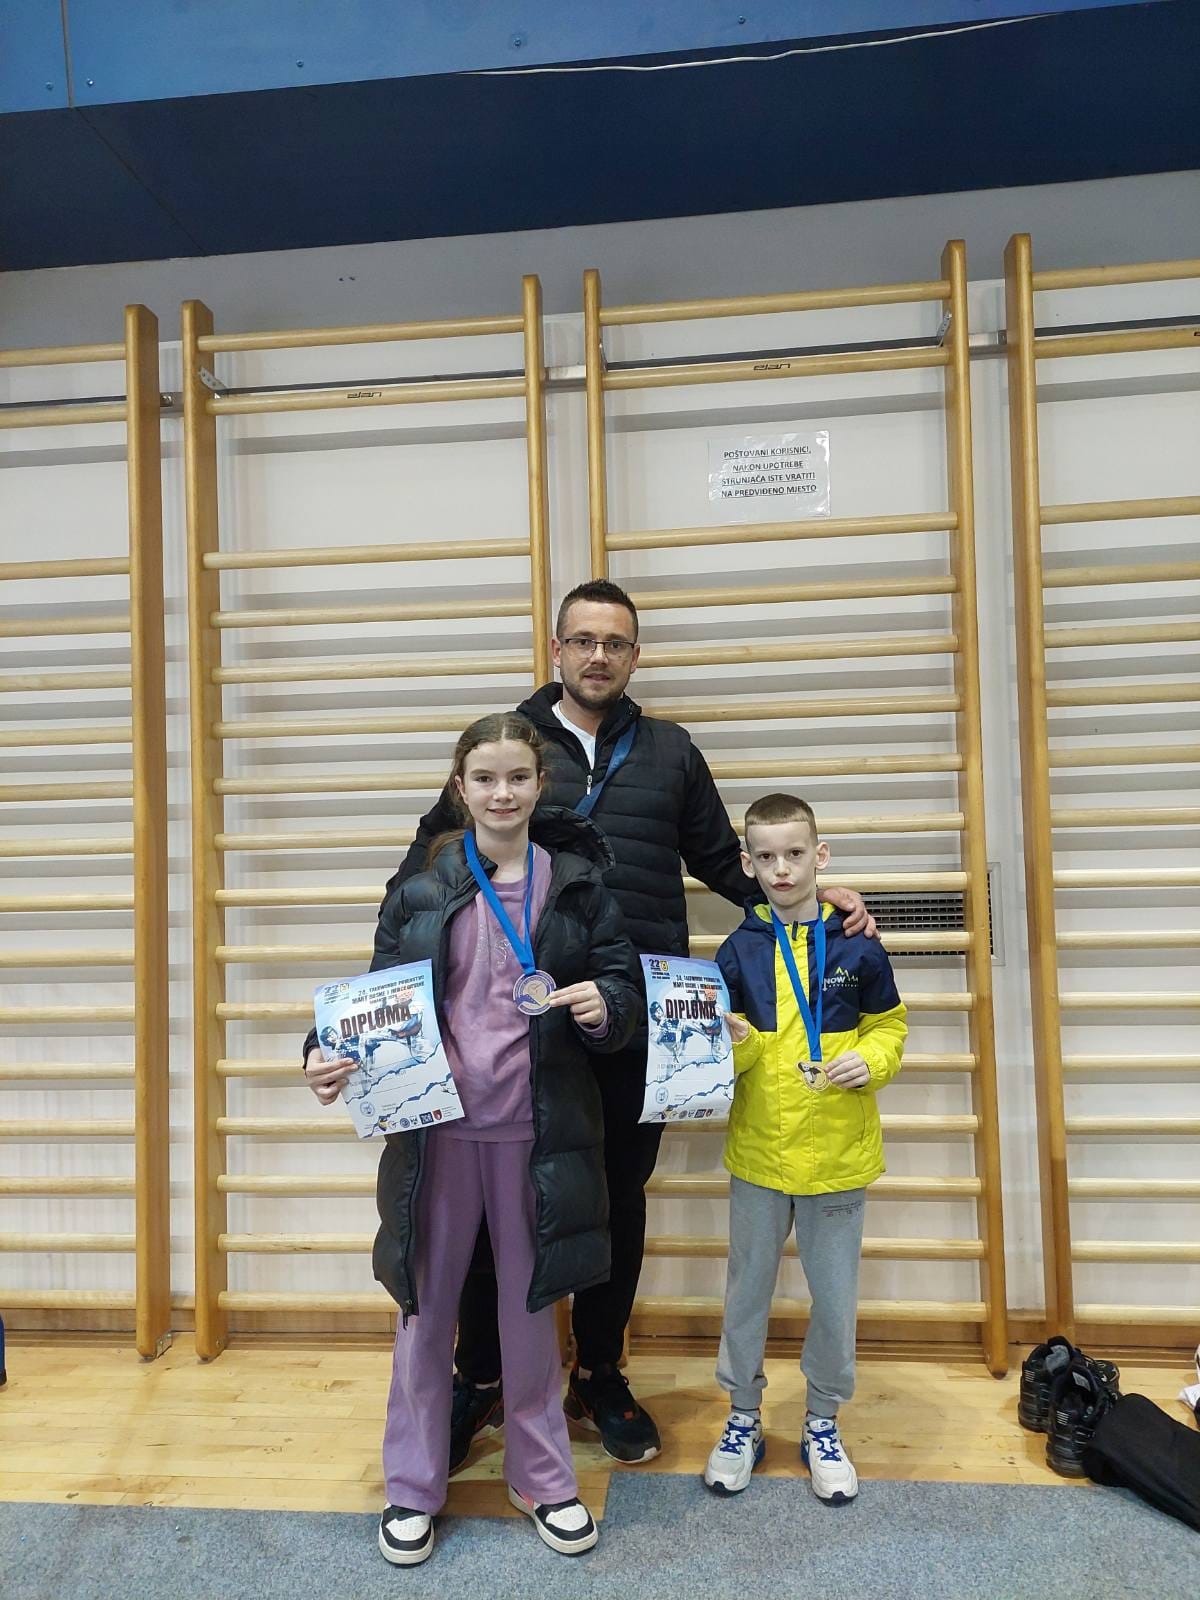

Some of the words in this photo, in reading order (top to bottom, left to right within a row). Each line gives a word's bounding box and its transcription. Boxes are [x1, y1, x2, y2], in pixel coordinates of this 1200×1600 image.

[723, 449, 769, 460] POŠTOVANI
[770, 445, 812, 456] KORISNICI,
[732, 463, 761, 473] NAKON
[763, 460, 804, 471] UPOTREBE
[721, 475, 766, 486] STRUNJAČA
[768, 474, 783, 482] ISTE
[785, 471, 816, 481] VRATITI
[721, 489, 733, 498] NA
[786, 484, 817, 494] MJESTO
[665, 998, 717, 1020] DIPLOMA
[340, 1003, 412, 1039] DIPLOMA
